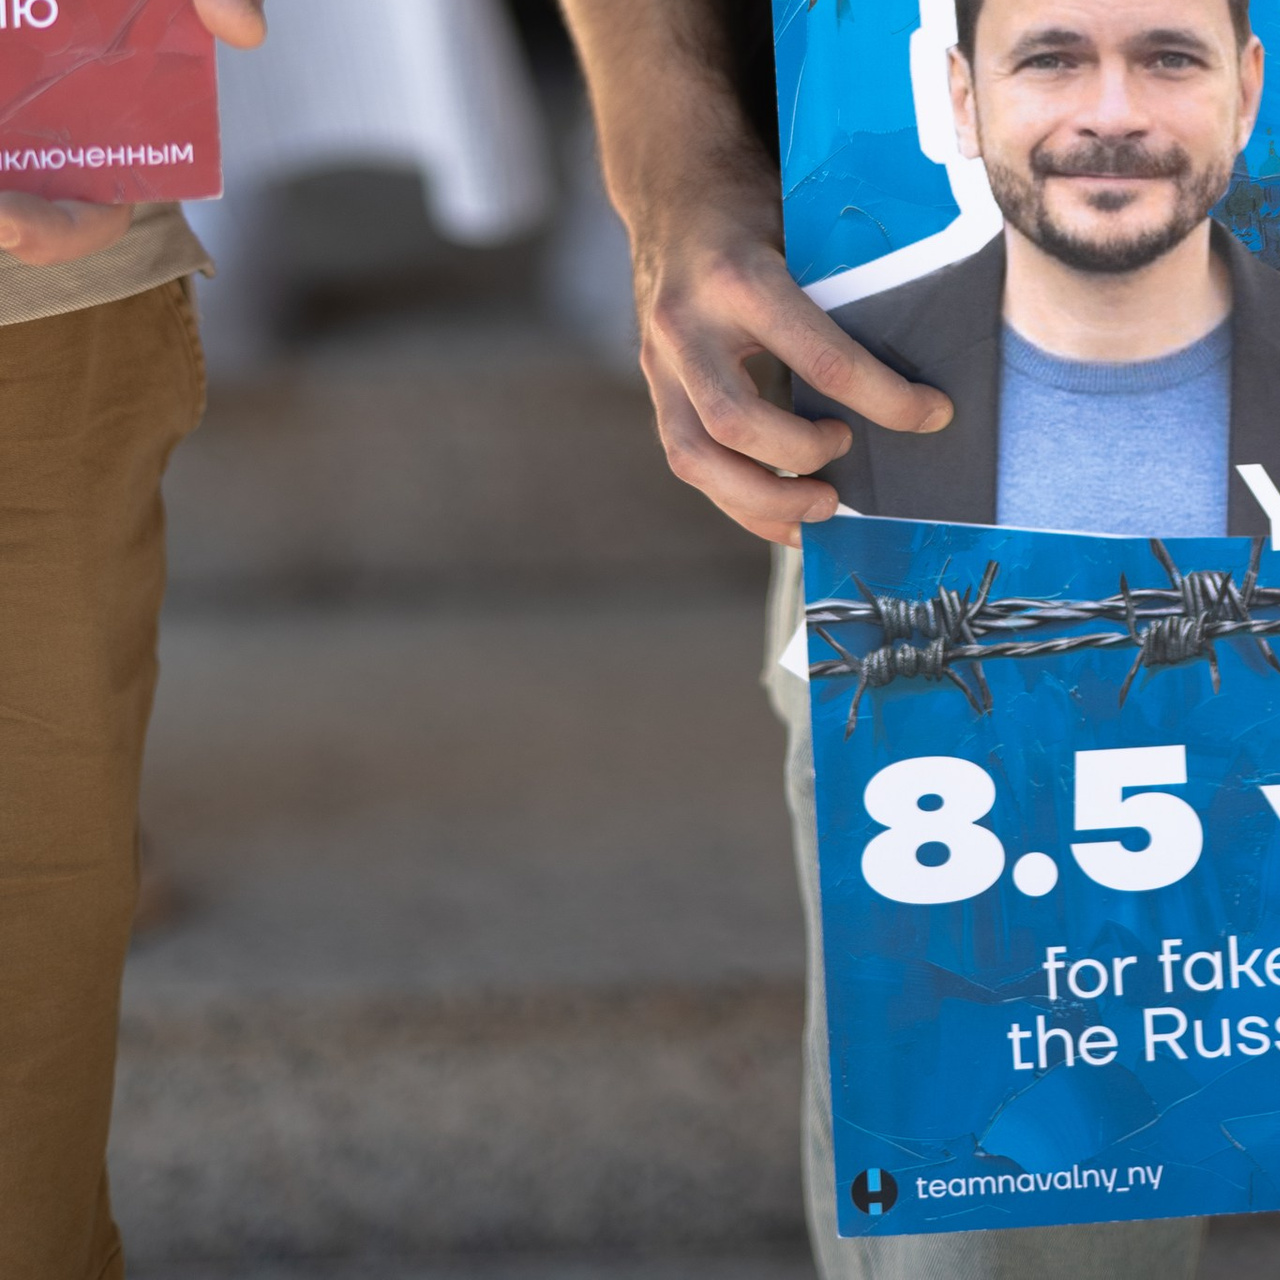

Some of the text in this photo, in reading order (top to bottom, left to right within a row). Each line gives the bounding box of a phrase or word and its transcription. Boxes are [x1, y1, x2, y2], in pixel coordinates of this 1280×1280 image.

[0, 142, 195, 171] ключенным
[860, 744, 1204, 906] 8.5
[1043, 945, 1138, 1002] for
[1007, 1014, 1119, 1071] the
[915, 1164, 1164, 1199] teamnavalny_ny
